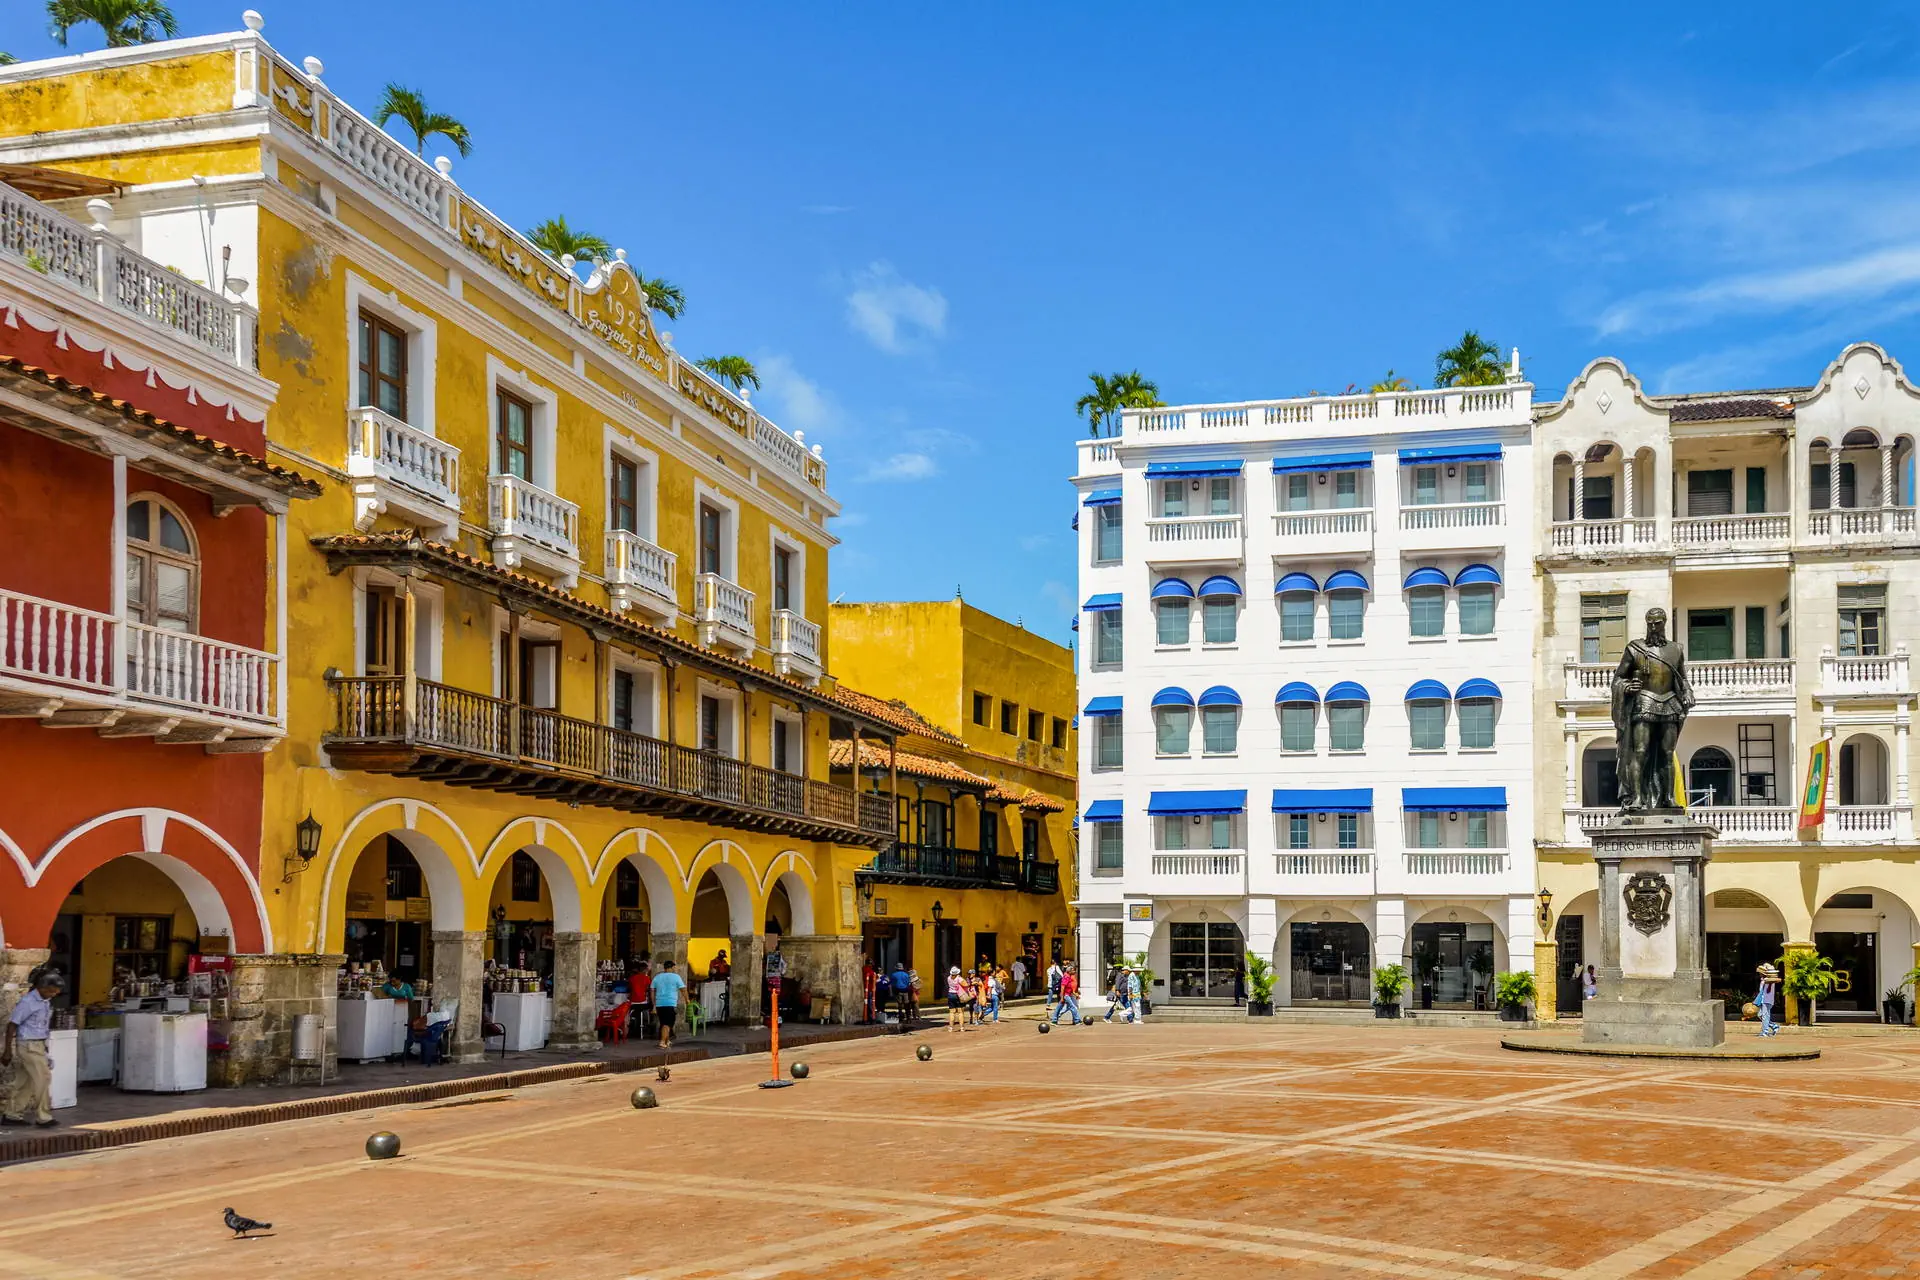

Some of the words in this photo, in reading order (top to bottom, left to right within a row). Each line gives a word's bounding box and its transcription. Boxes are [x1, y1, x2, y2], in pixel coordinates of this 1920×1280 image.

[606, 294, 648, 340] 1922
[1596, 841, 1635, 852] PEDRO
[1647, 840, 1696, 851] HEREDIA
